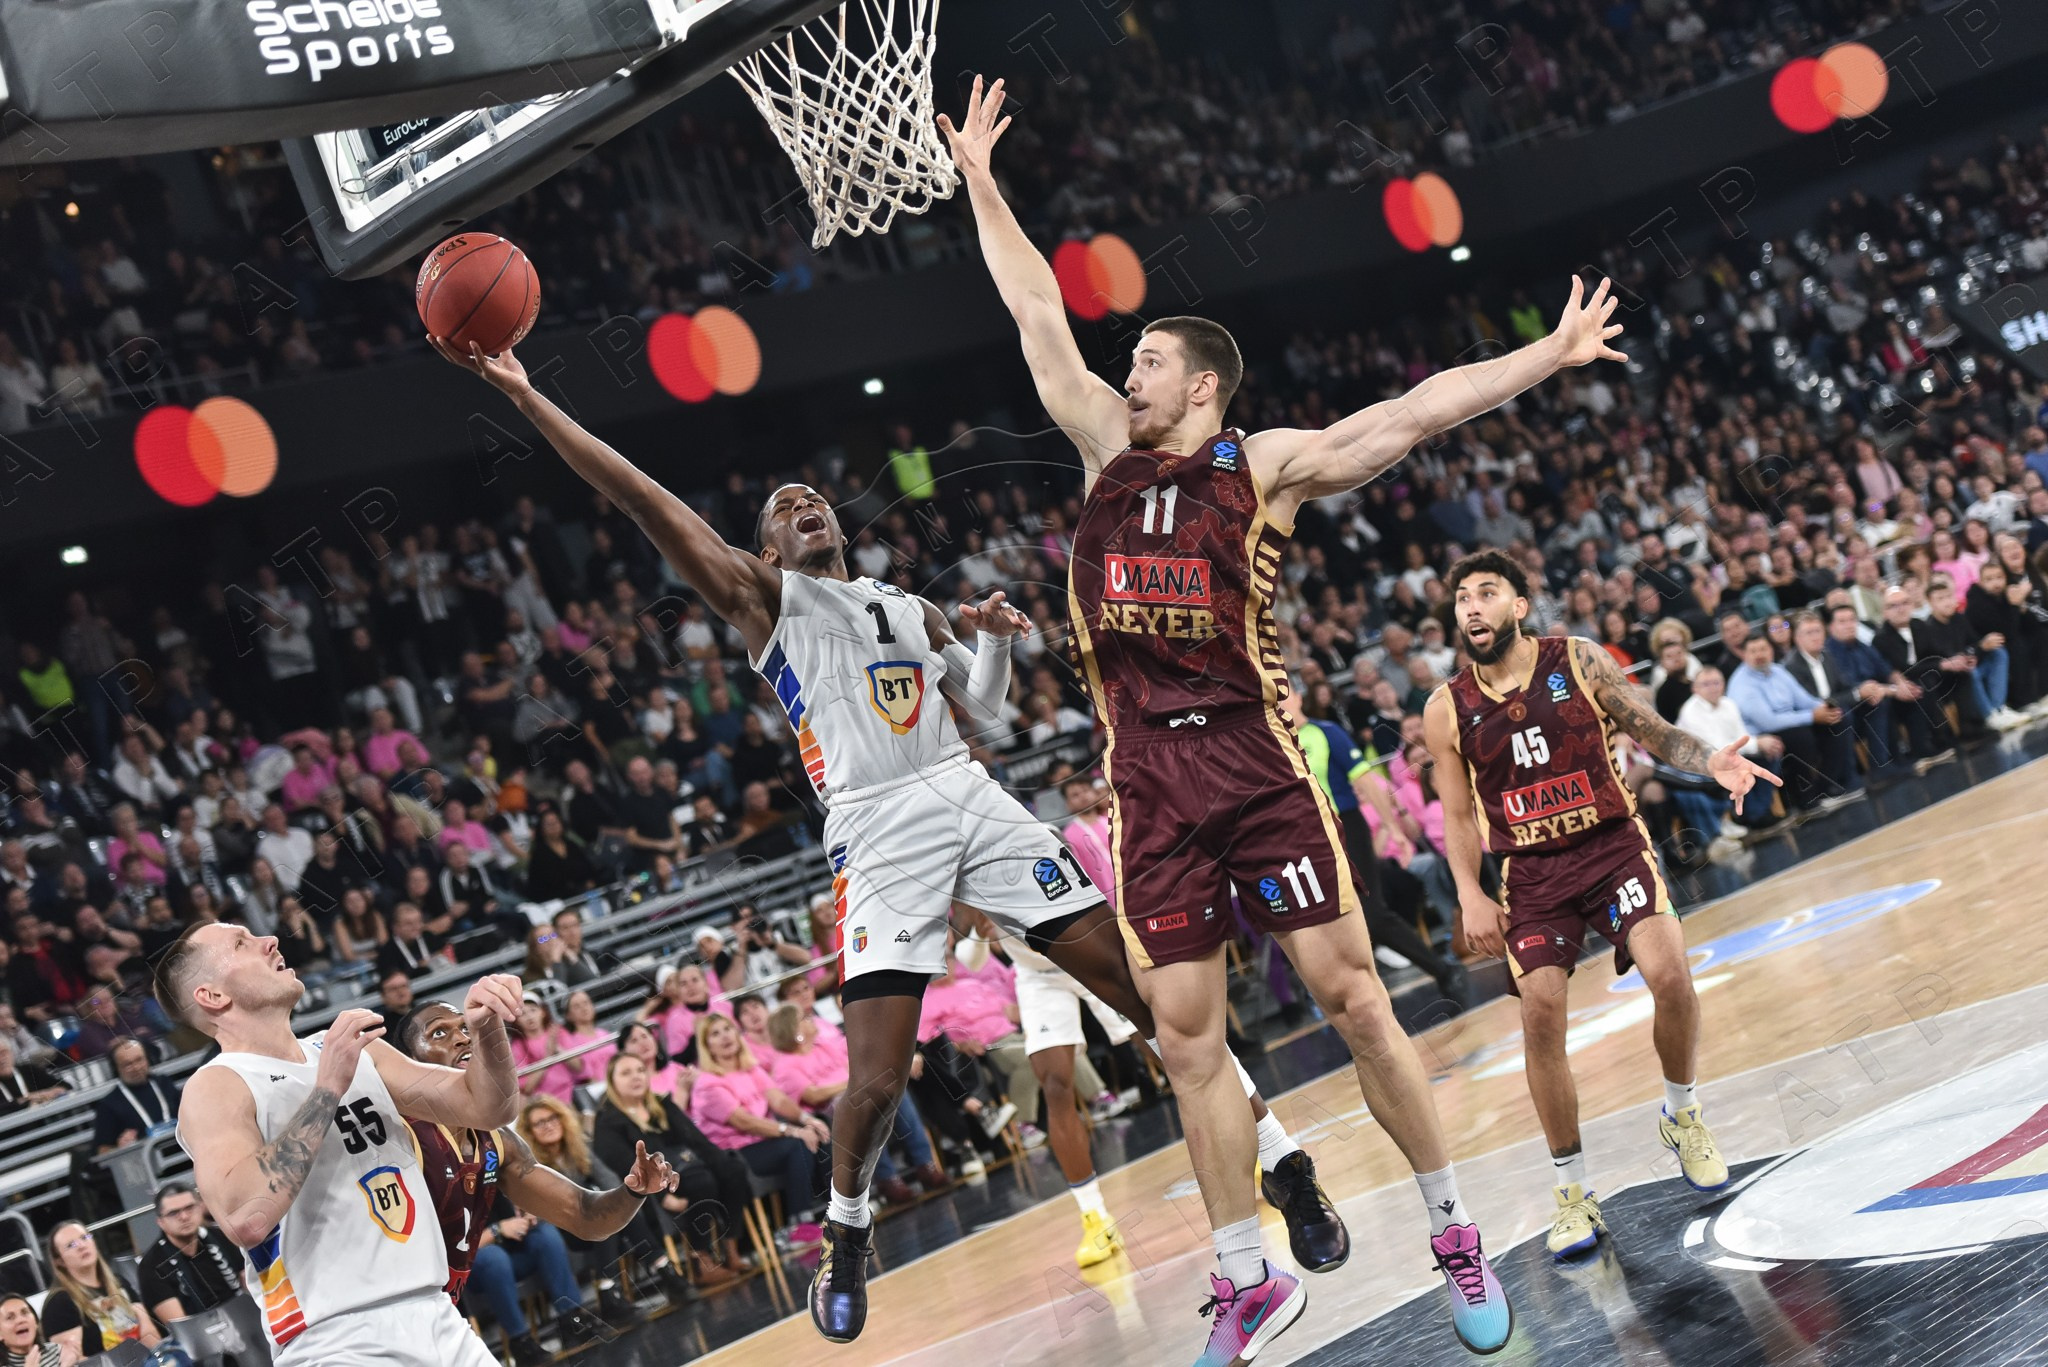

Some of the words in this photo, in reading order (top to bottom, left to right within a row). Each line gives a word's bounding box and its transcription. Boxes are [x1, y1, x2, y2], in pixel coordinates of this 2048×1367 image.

[259, 25, 454, 82] Sports
[383, 117, 430, 146] EuroCup
[2000, 310, 2048, 351] SH
[1212, 460, 1237, 472] EuroCup
[1139, 485, 1179, 534] 11
[1110, 560, 1205, 598] UMANA
[865, 602, 897, 645] 1
[1100, 602, 1218, 639] REYER
[879, 677, 913, 702] BT
[1510, 725, 1551, 769] 45
[1506, 779, 1586, 817] UMANA
[1510, 805, 1601, 847] REYER
[1059, 846, 1093, 889] 1
[1281, 855, 1326, 909] 11
[1047, 884, 1070, 898] EuroCup
[1616, 877, 1648, 916] 45
[1149, 915, 1184, 931] UMANA
[333, 1096, 387, 1155] 55
[374, 1182, 400, 1212] BT
